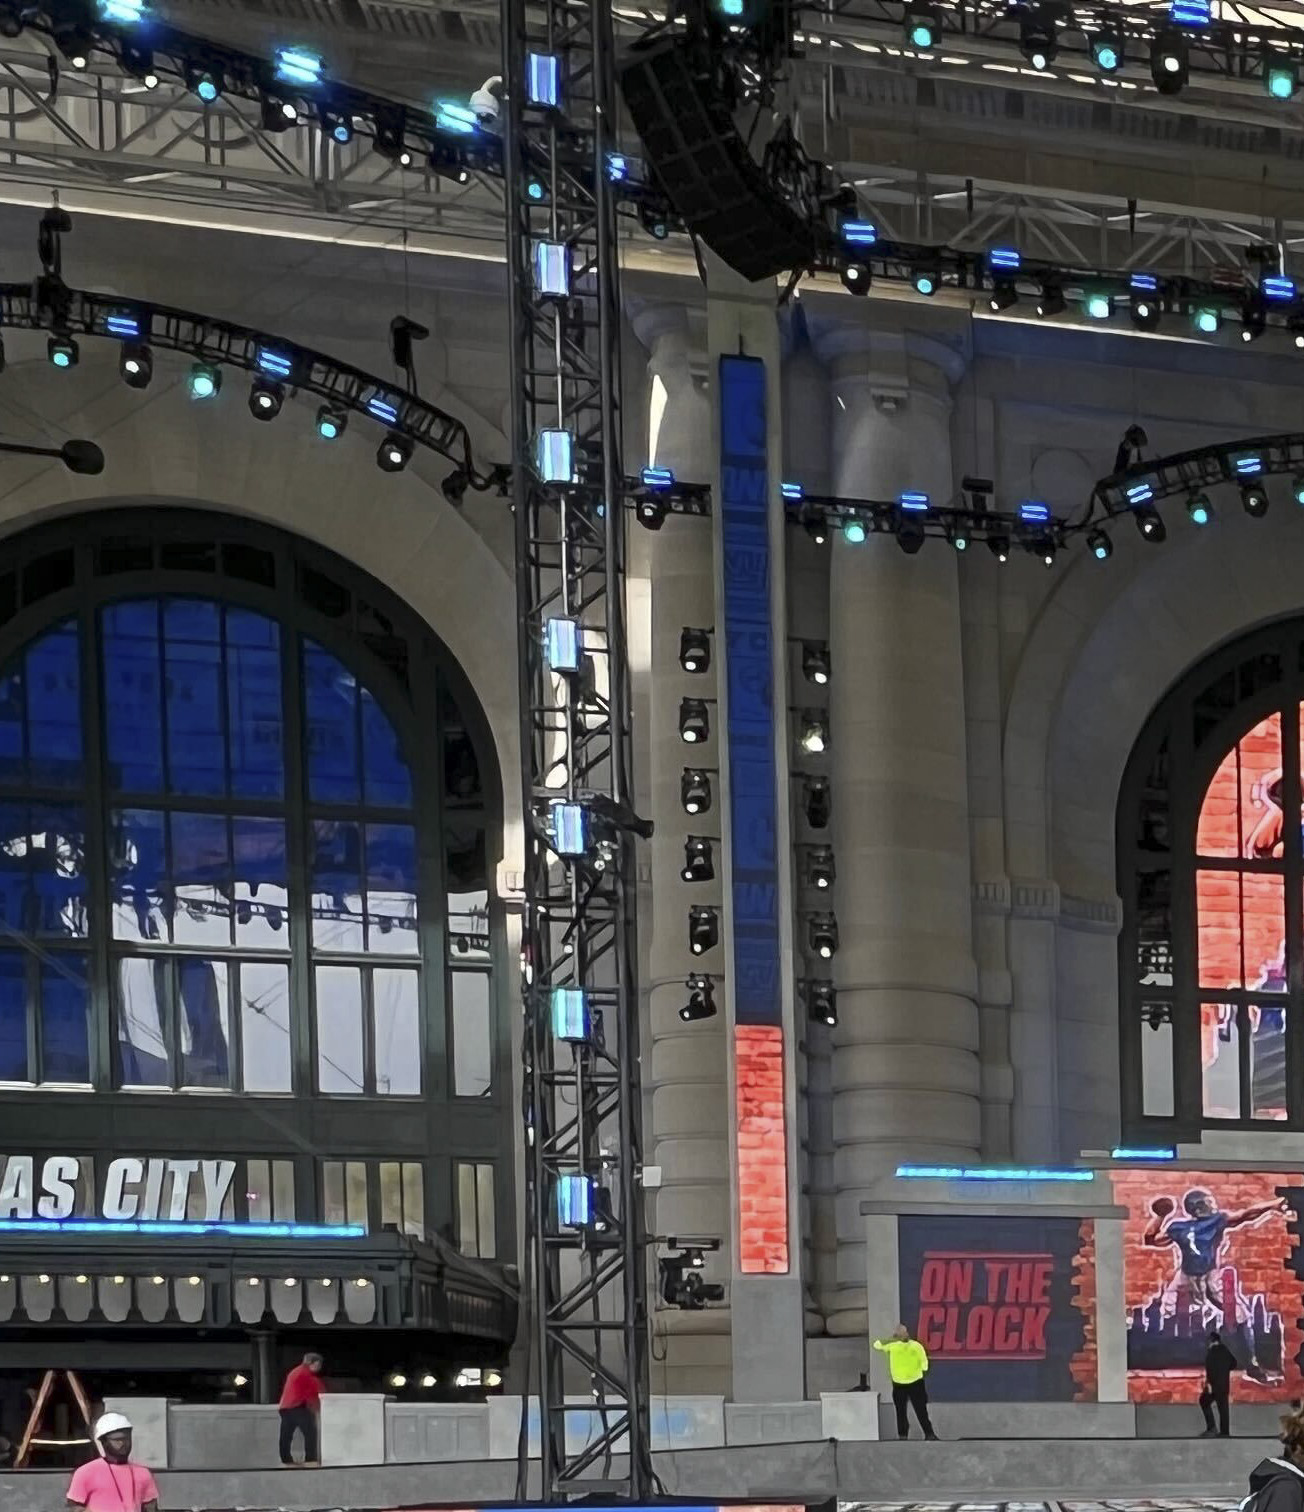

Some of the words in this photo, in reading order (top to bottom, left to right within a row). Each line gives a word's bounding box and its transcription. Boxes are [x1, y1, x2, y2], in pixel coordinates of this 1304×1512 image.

[102, 1158, 237, 1221] CITY
[920, 1259, 973, 1304] ON
[984, 1259, 1054, 1305] THE
[917, 1305, 1051, 1353] CLOCK
